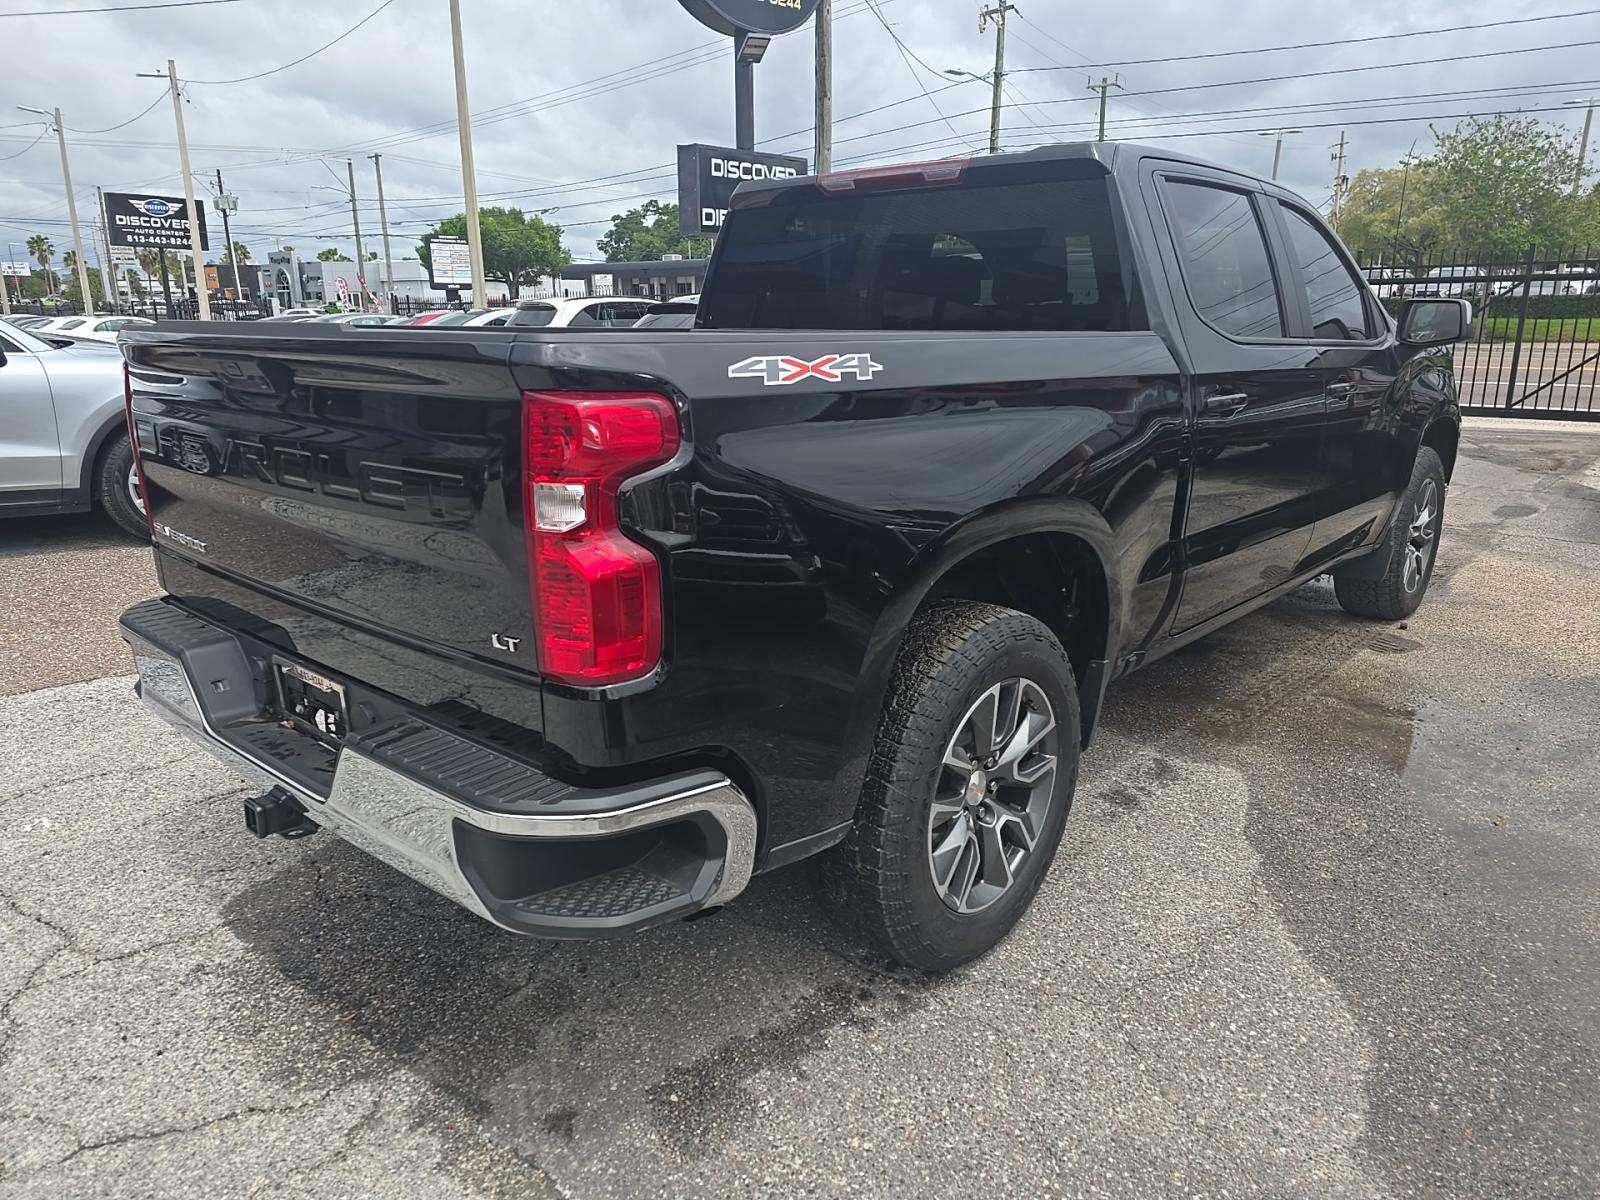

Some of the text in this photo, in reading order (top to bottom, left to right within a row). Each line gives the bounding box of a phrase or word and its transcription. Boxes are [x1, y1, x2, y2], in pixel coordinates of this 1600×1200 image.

[156, 229, 186, 237] CENTER
[728, 353, 884, 386] 4X4
[491, 633, 521, 652] LT
